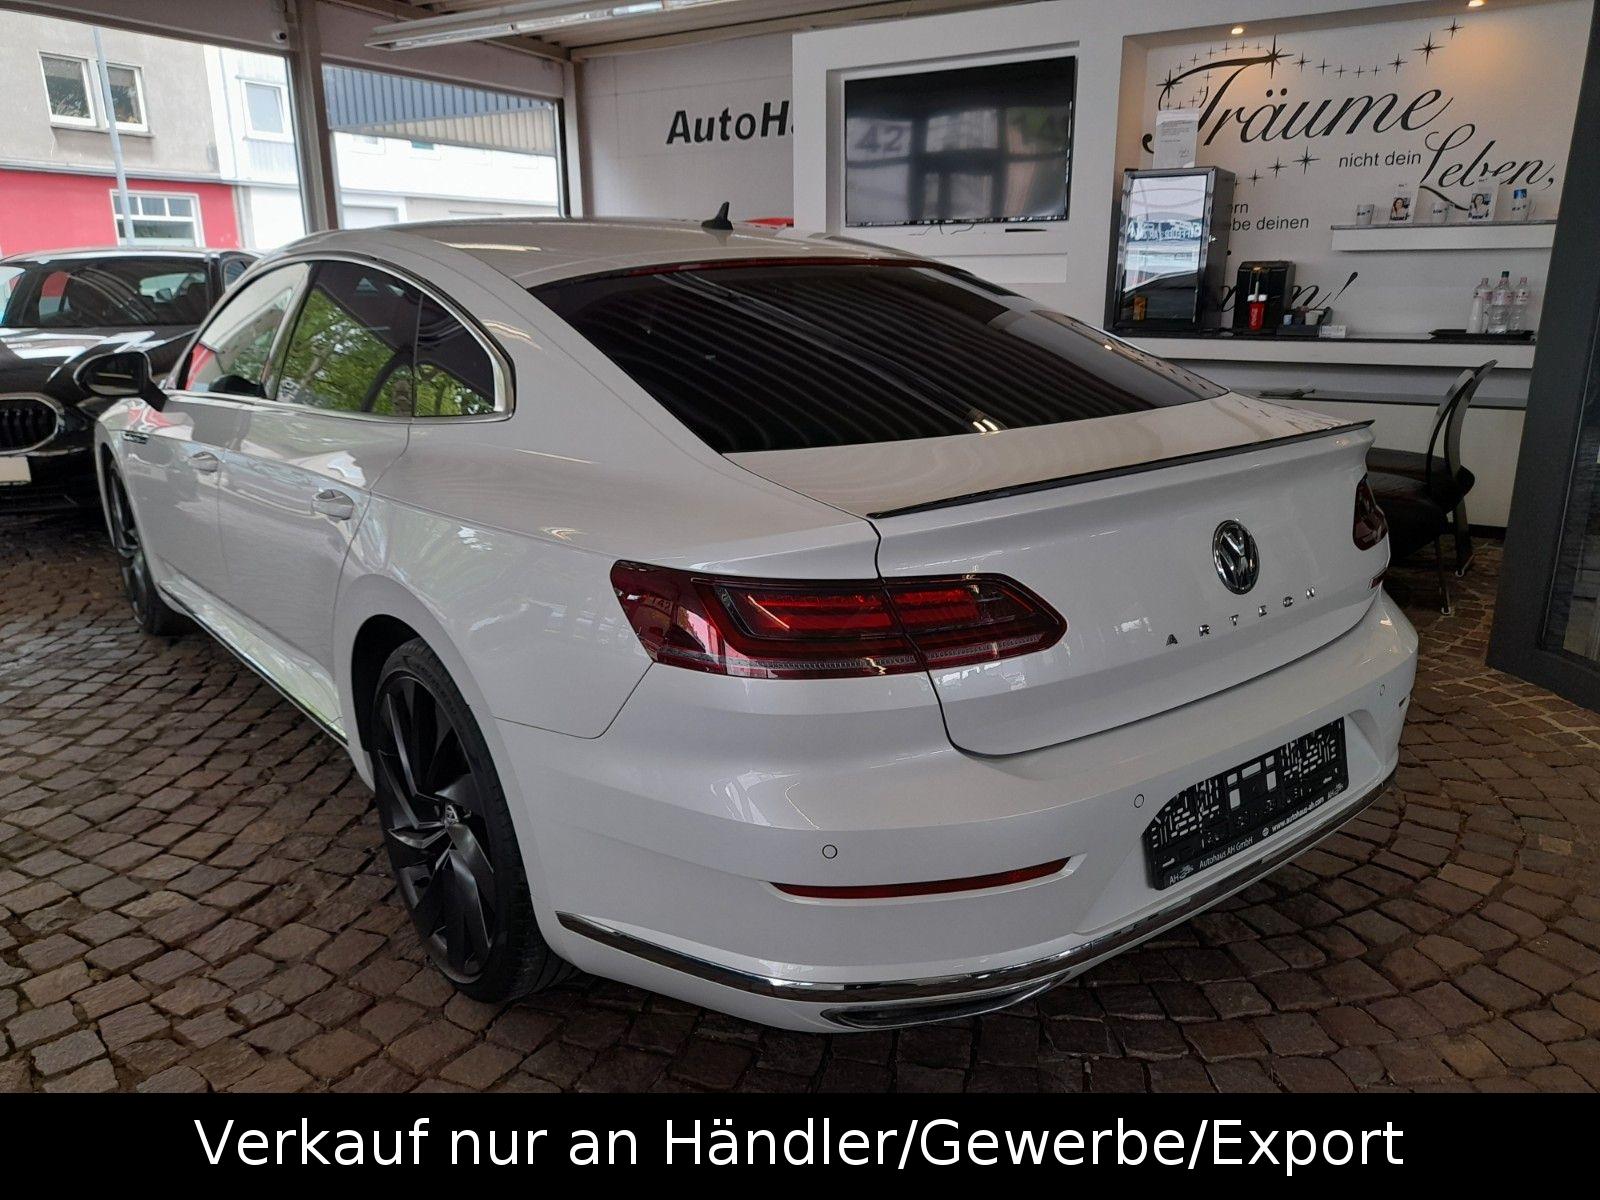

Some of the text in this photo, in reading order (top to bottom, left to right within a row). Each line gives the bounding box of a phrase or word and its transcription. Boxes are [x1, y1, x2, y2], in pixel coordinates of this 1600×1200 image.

[1142, 52, 1453, 153] Träume
[665, 100, 794, 145] AutoH
[1338, 152, 1380, 169] nicht
[1384, 150, 1422, 167] dein
[1230, 216, 1309, 232] be deinen
[1165, 586, 1316, 646] ARTEON
[1199, 851, 1227, 869] Autohaus
[1235, 835, 1254, 851] GmbH
